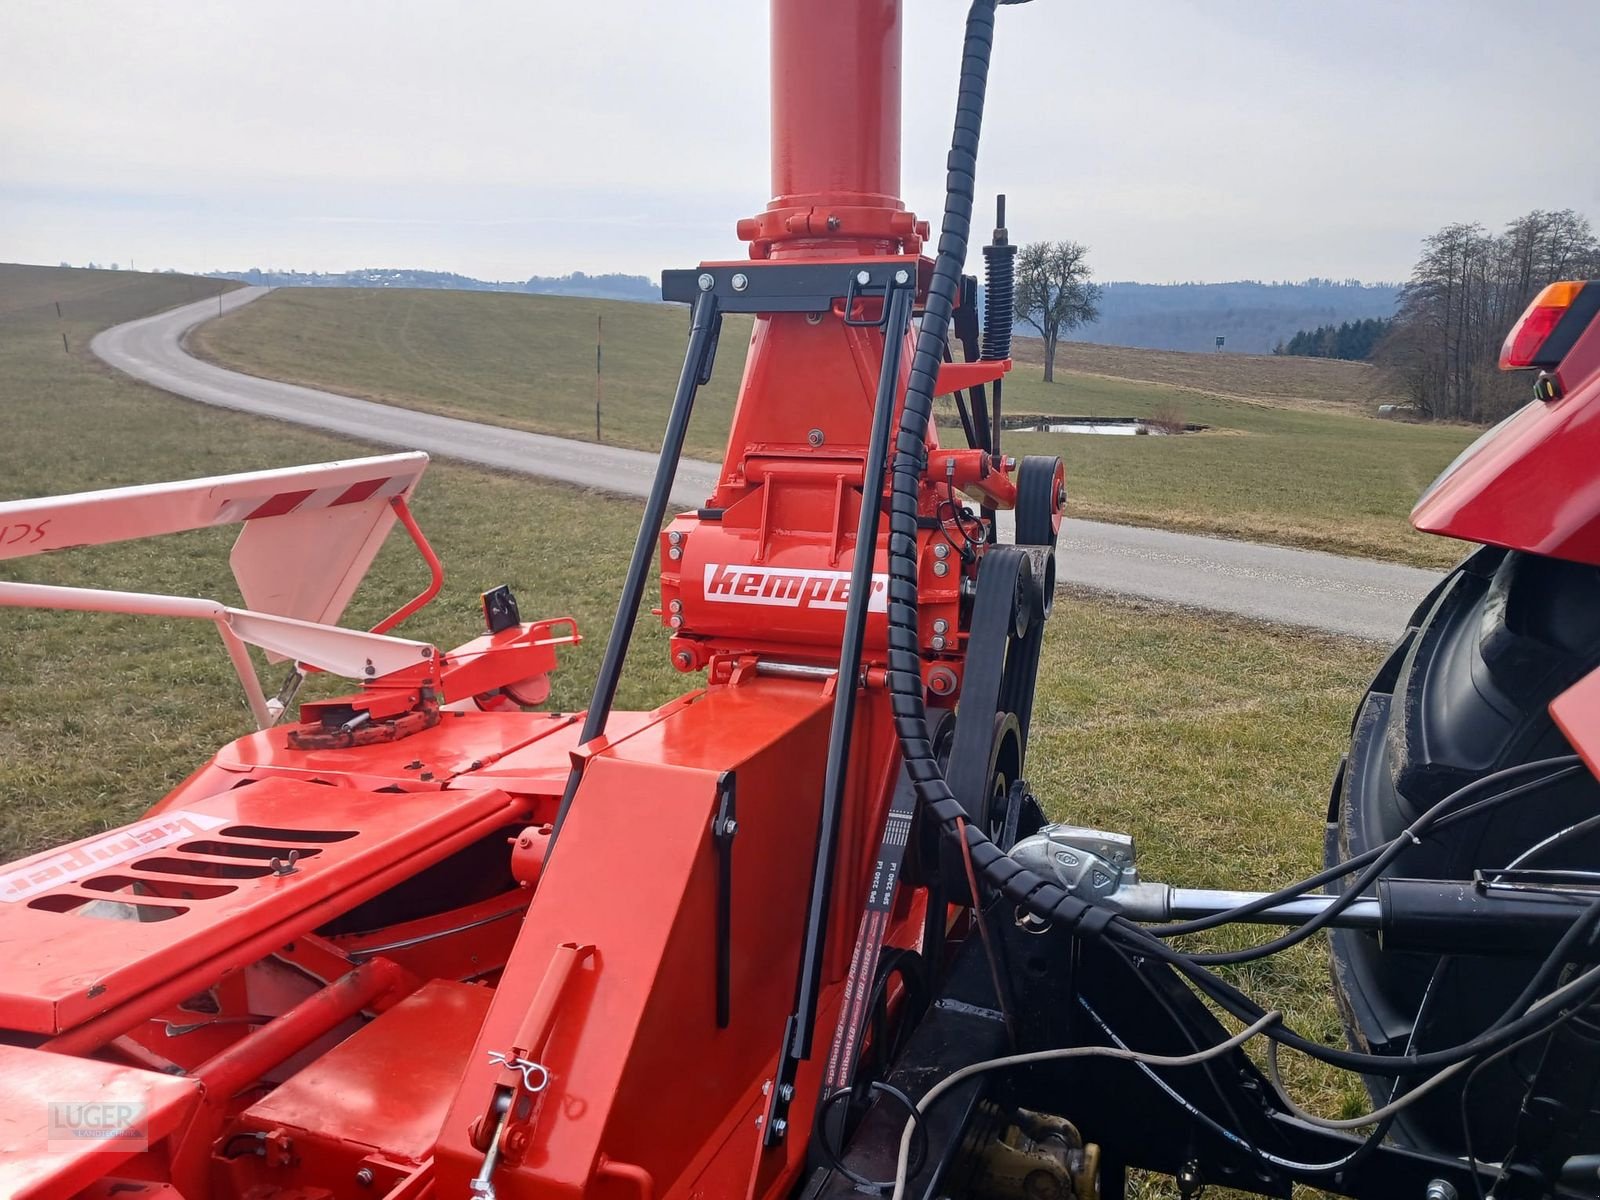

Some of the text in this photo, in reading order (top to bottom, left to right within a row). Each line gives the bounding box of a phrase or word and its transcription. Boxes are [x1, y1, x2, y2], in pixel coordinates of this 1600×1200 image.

[5, 816, 205, 895] kemper
[872, 871, 880, 889] 2240
[886, 873, 894, 890] 2240
[827, 1039, 841, 1083] optibelt
[844, 980, 853, 999] RED
[849, 948, 860, 979] POWER
[839, 1041, 852, 1085] optibelt
[856, 982, 864, 1000] RED
[861, 950, 871, 981] POWER
